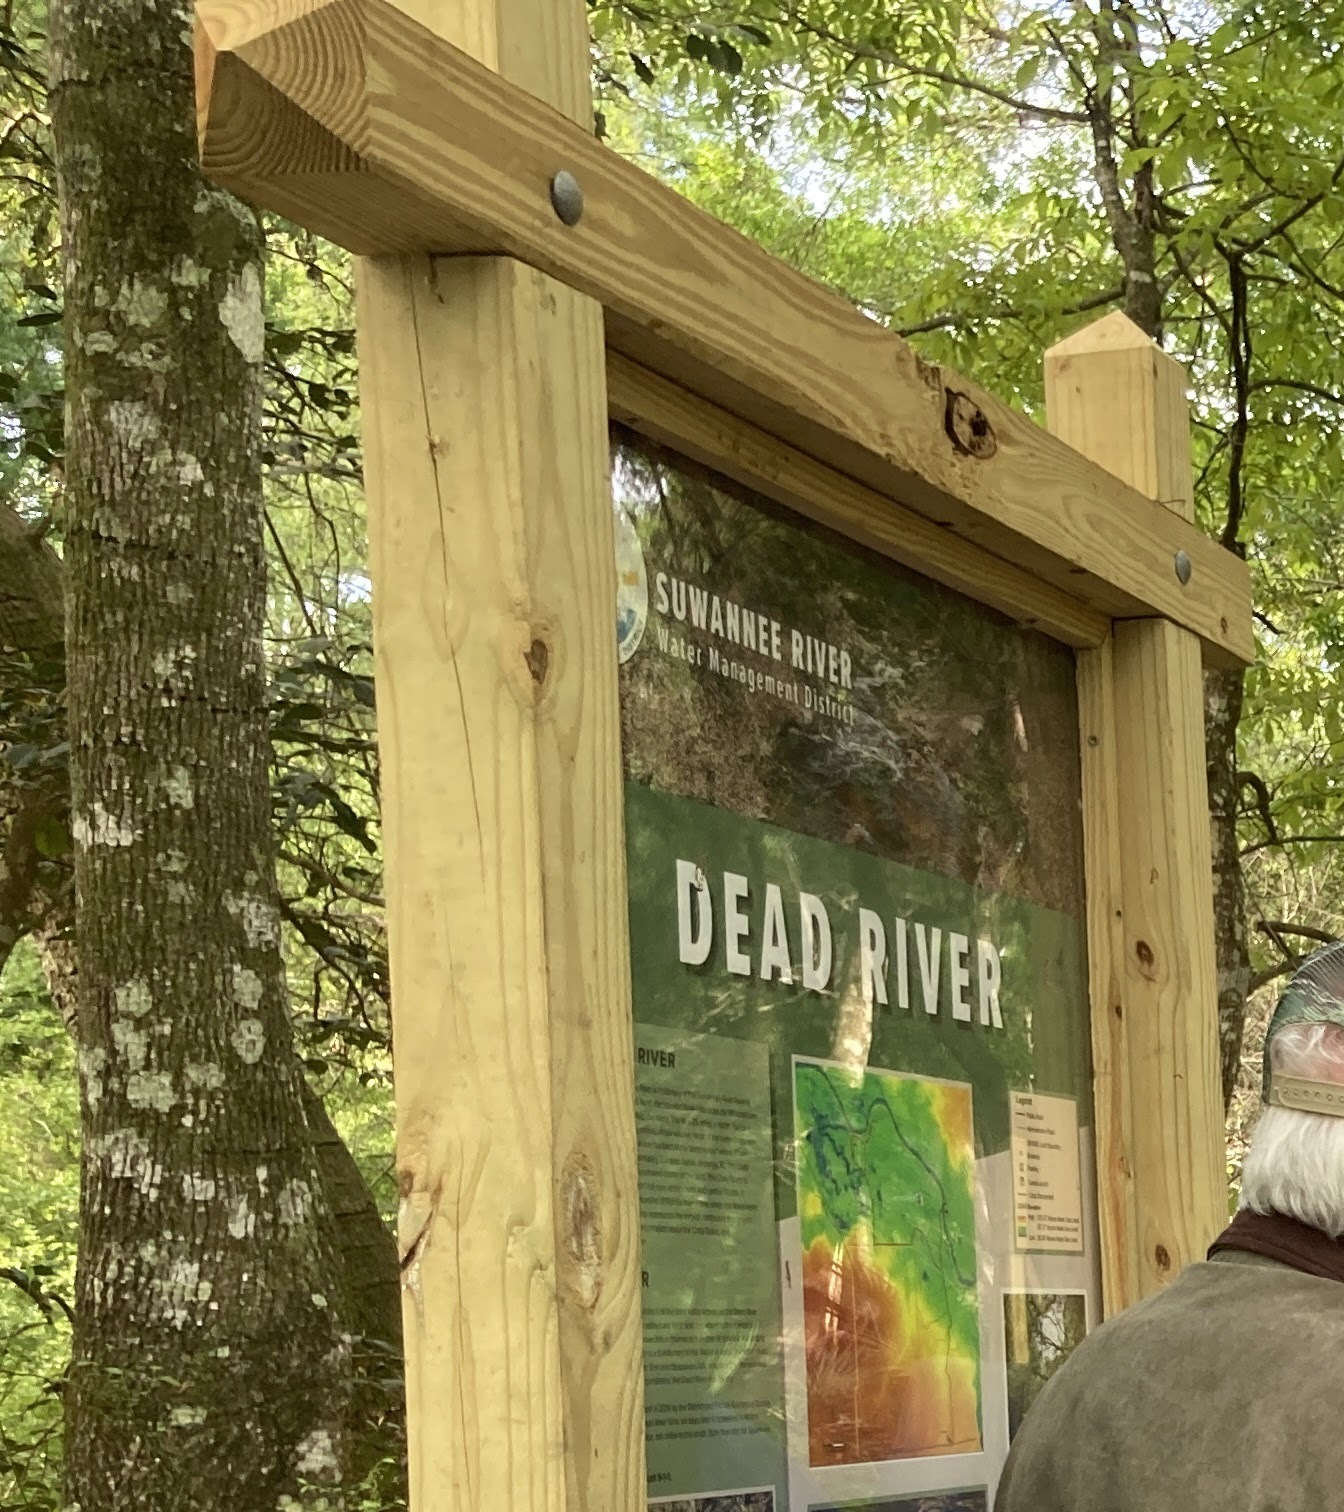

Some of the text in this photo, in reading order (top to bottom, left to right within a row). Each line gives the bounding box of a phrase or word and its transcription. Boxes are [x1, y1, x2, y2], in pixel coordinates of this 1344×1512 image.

[655, 571, 782, 661] SUWANNEE
[791, 629, 853, 689] RIVER
[657, 626, 702, 666] Water
[709, 647, 798, 704] Management
[804, 685, 854, 726] District
[676, 858, 1004, 1029] DEAD RIVER
[637, 1047, 676, 1069] RIVER
